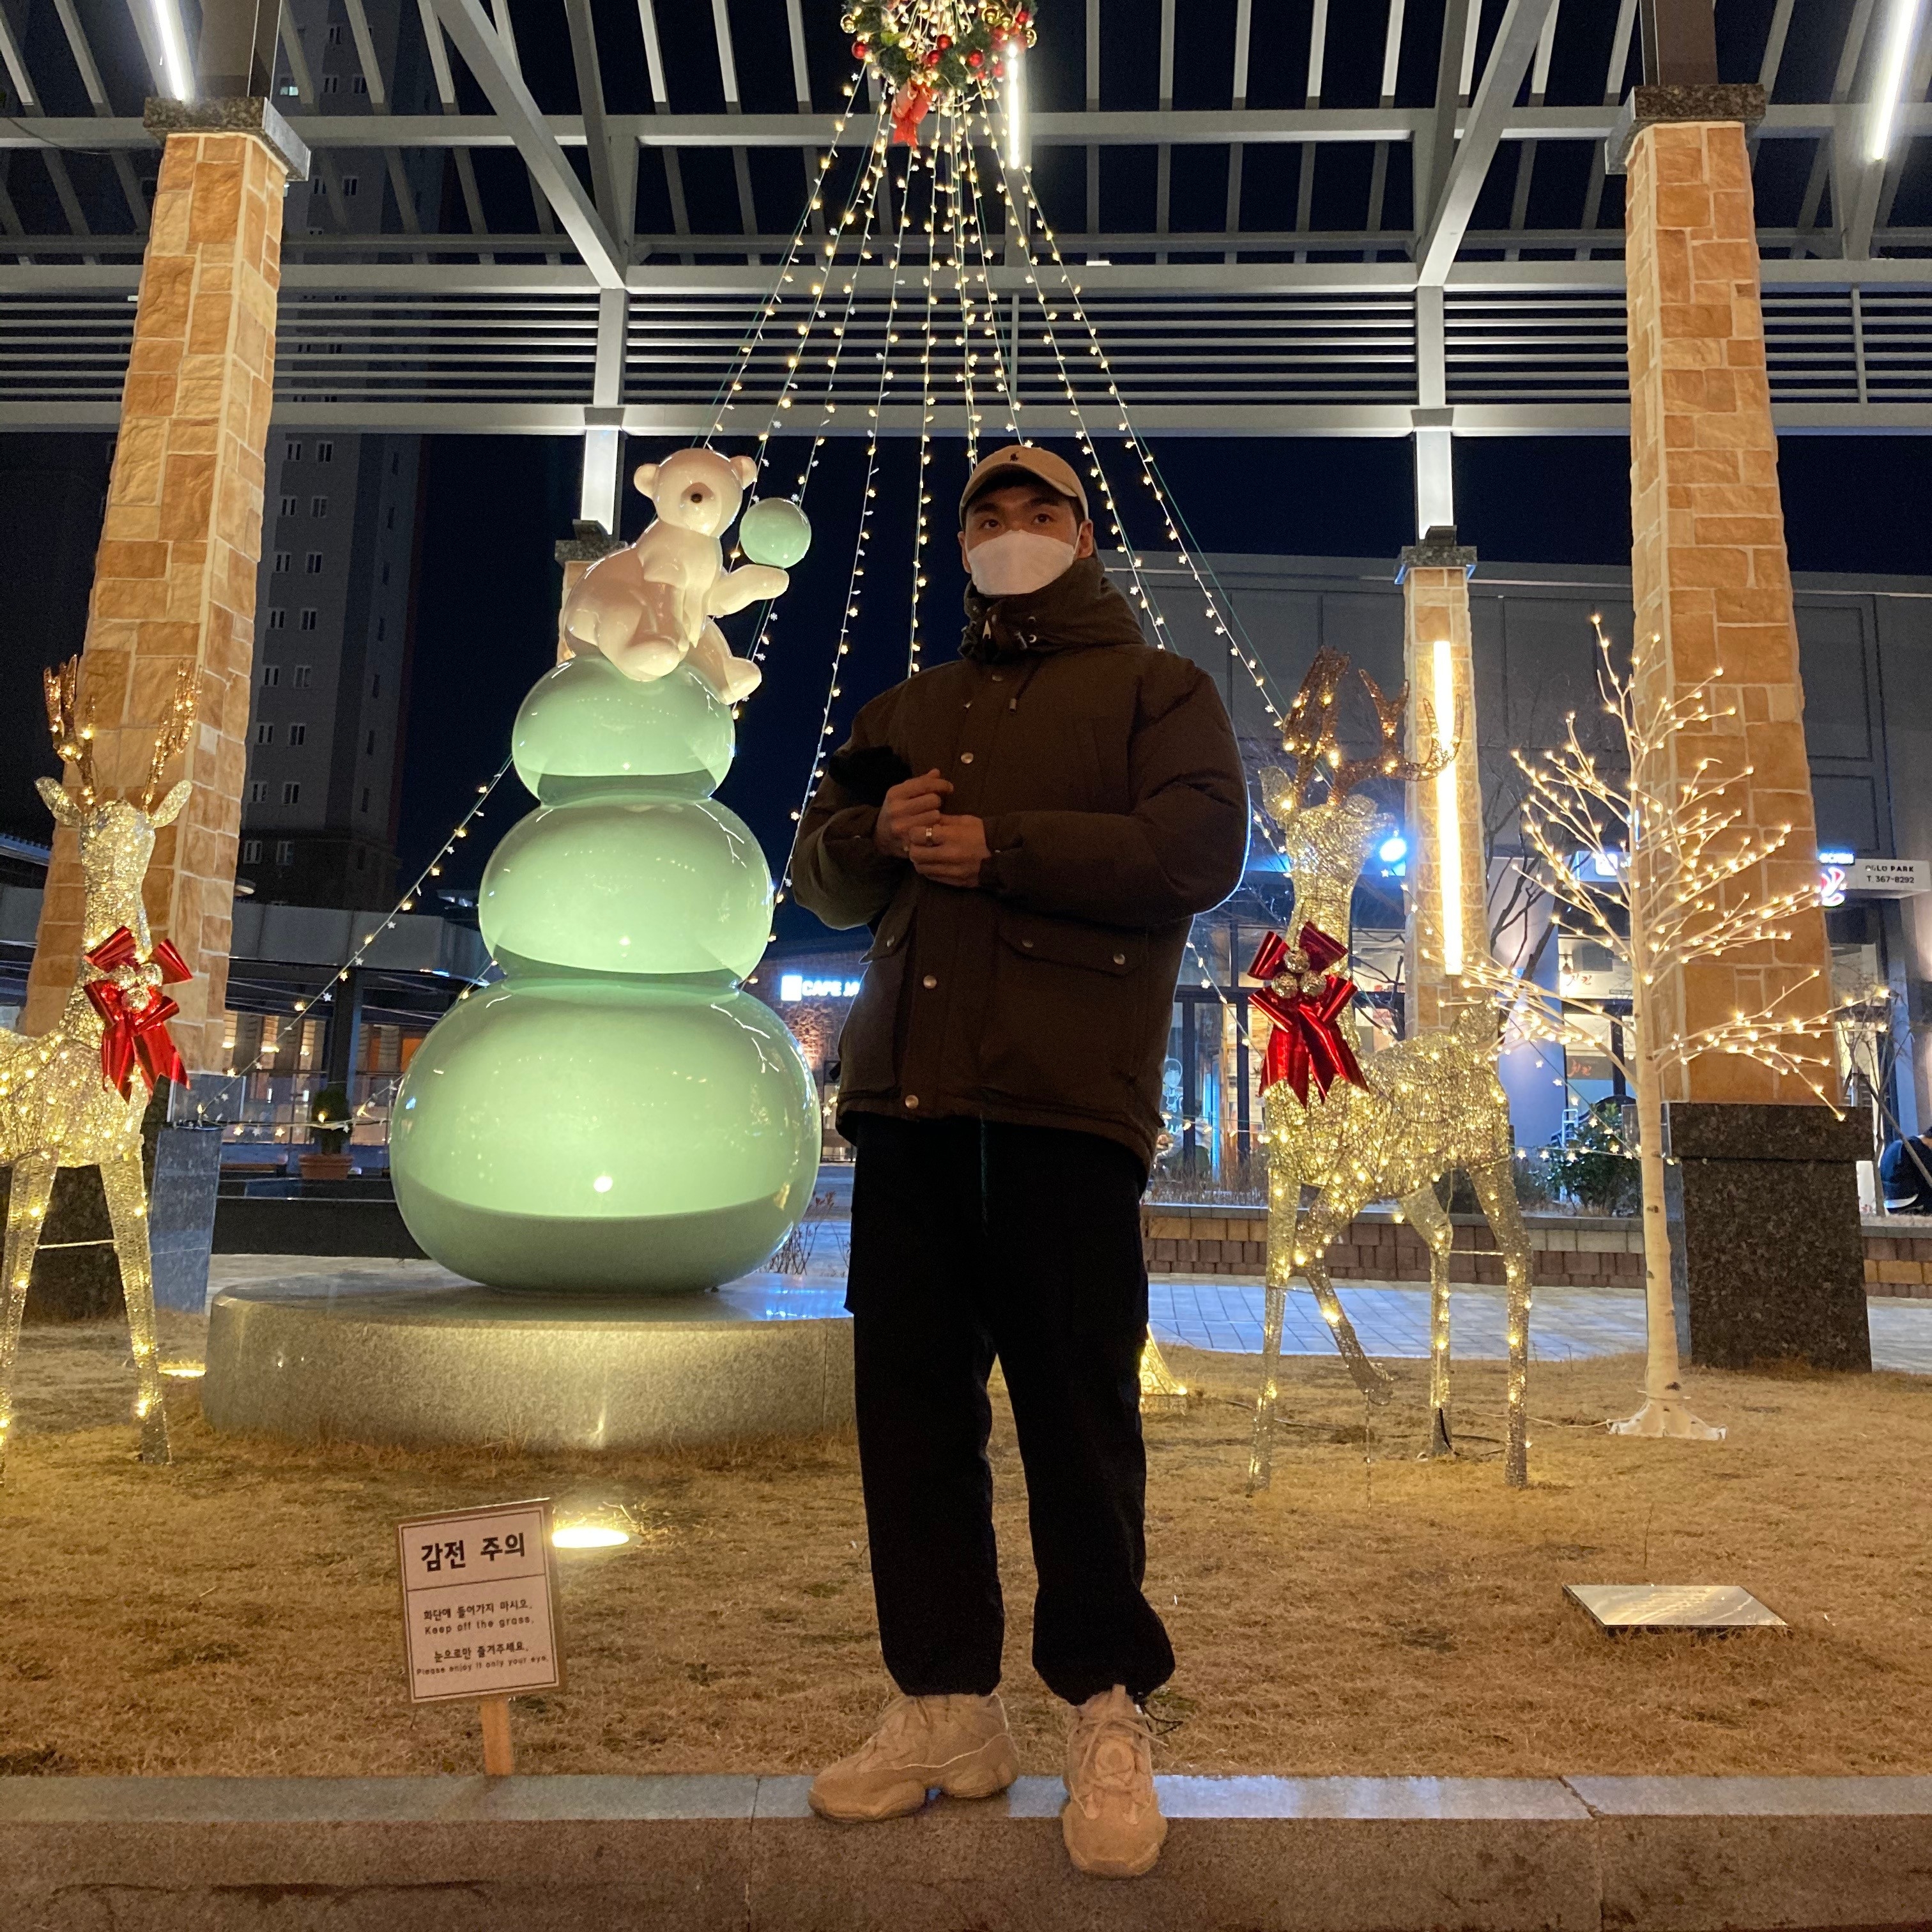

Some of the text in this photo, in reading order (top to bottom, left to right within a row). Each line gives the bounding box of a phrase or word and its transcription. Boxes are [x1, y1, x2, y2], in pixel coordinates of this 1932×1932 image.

[1876, 875, 1914, 884] 367-8292
[802, 981, 842, 996] CAFE
[421, 1532, 525, 1572] 감전 주의
[424, 1607, 451, 1621] 화단에
[457, 1602, 494, 1618] 들어가지
[425, 1625, 452, 1635] Keep
[457, 1621, 471, 1631] off
[477, 1620, 494, 1629] the
[434, 1647, 471, 1663] 눈으로만
[417, 1667, 445, 1675] Please
[449, 1664, 472, 1673] enjoy
[486, 1659, 504, 1668] only
[508, 1657, 526, 1666] your
